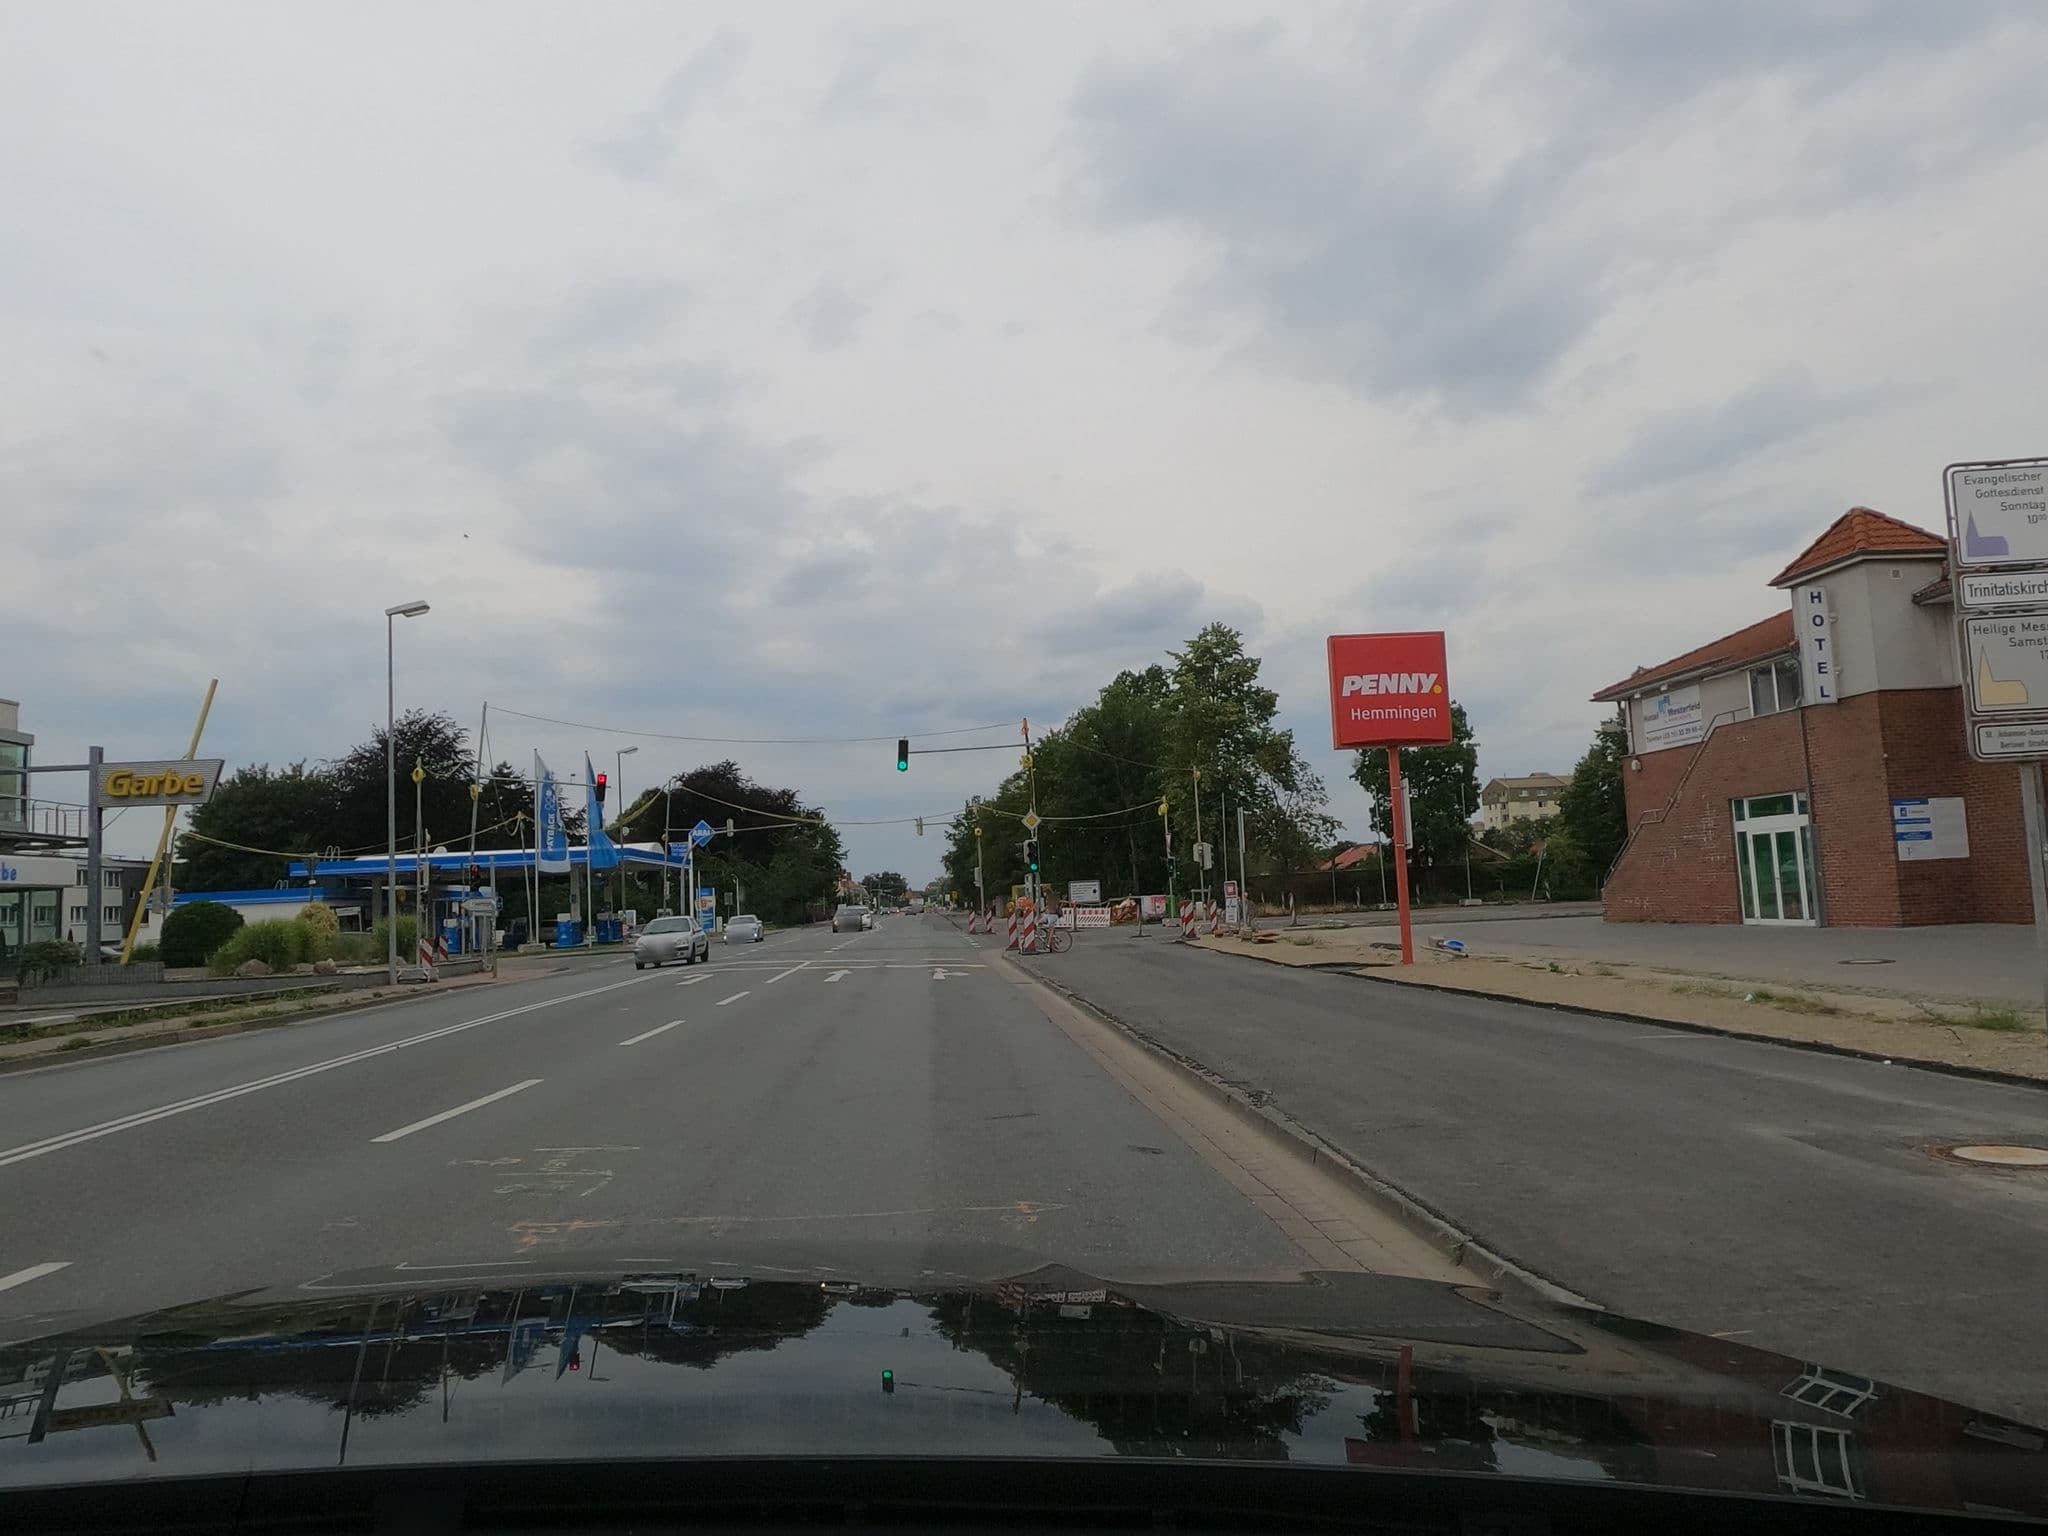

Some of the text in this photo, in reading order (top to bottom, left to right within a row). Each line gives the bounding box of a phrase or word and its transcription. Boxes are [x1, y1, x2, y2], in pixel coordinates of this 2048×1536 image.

[1964, 473, 2041, 485] Evangelischer
[1975, 486, 2044, 499] Gottesdienst
[2001, 501, 2046, 512] Sonntag
[1973, 622, 2048, 636] Heilige Mes
[1810, 591, 1830, 698] HOTEL
[1351, 705, 1437, 721] Hemmingen
[106, 768, 204, 797] Garbe
